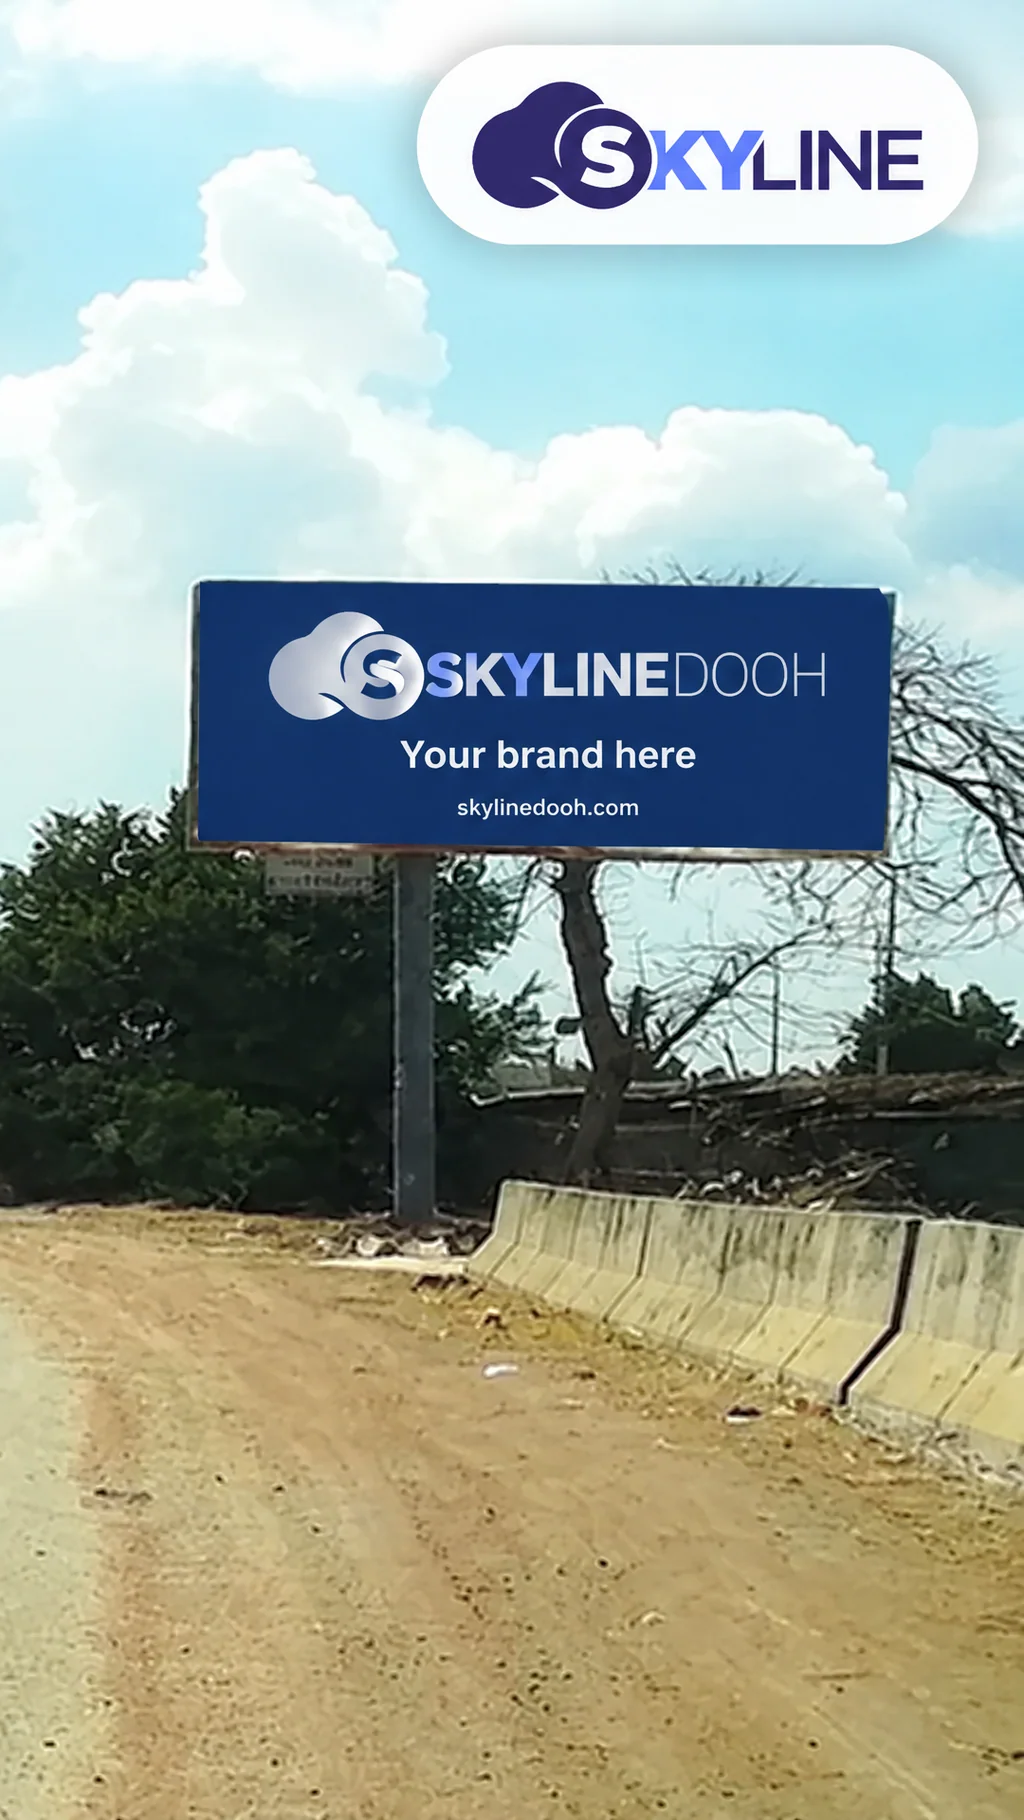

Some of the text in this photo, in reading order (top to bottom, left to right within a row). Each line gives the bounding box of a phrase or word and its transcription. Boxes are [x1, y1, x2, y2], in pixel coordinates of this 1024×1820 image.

[425, 651, 826, 698] SKYLINEDOOH
[400, 739, 696, 769] Your brand here
[457, 798, 639, 818] skylinedooh.com
